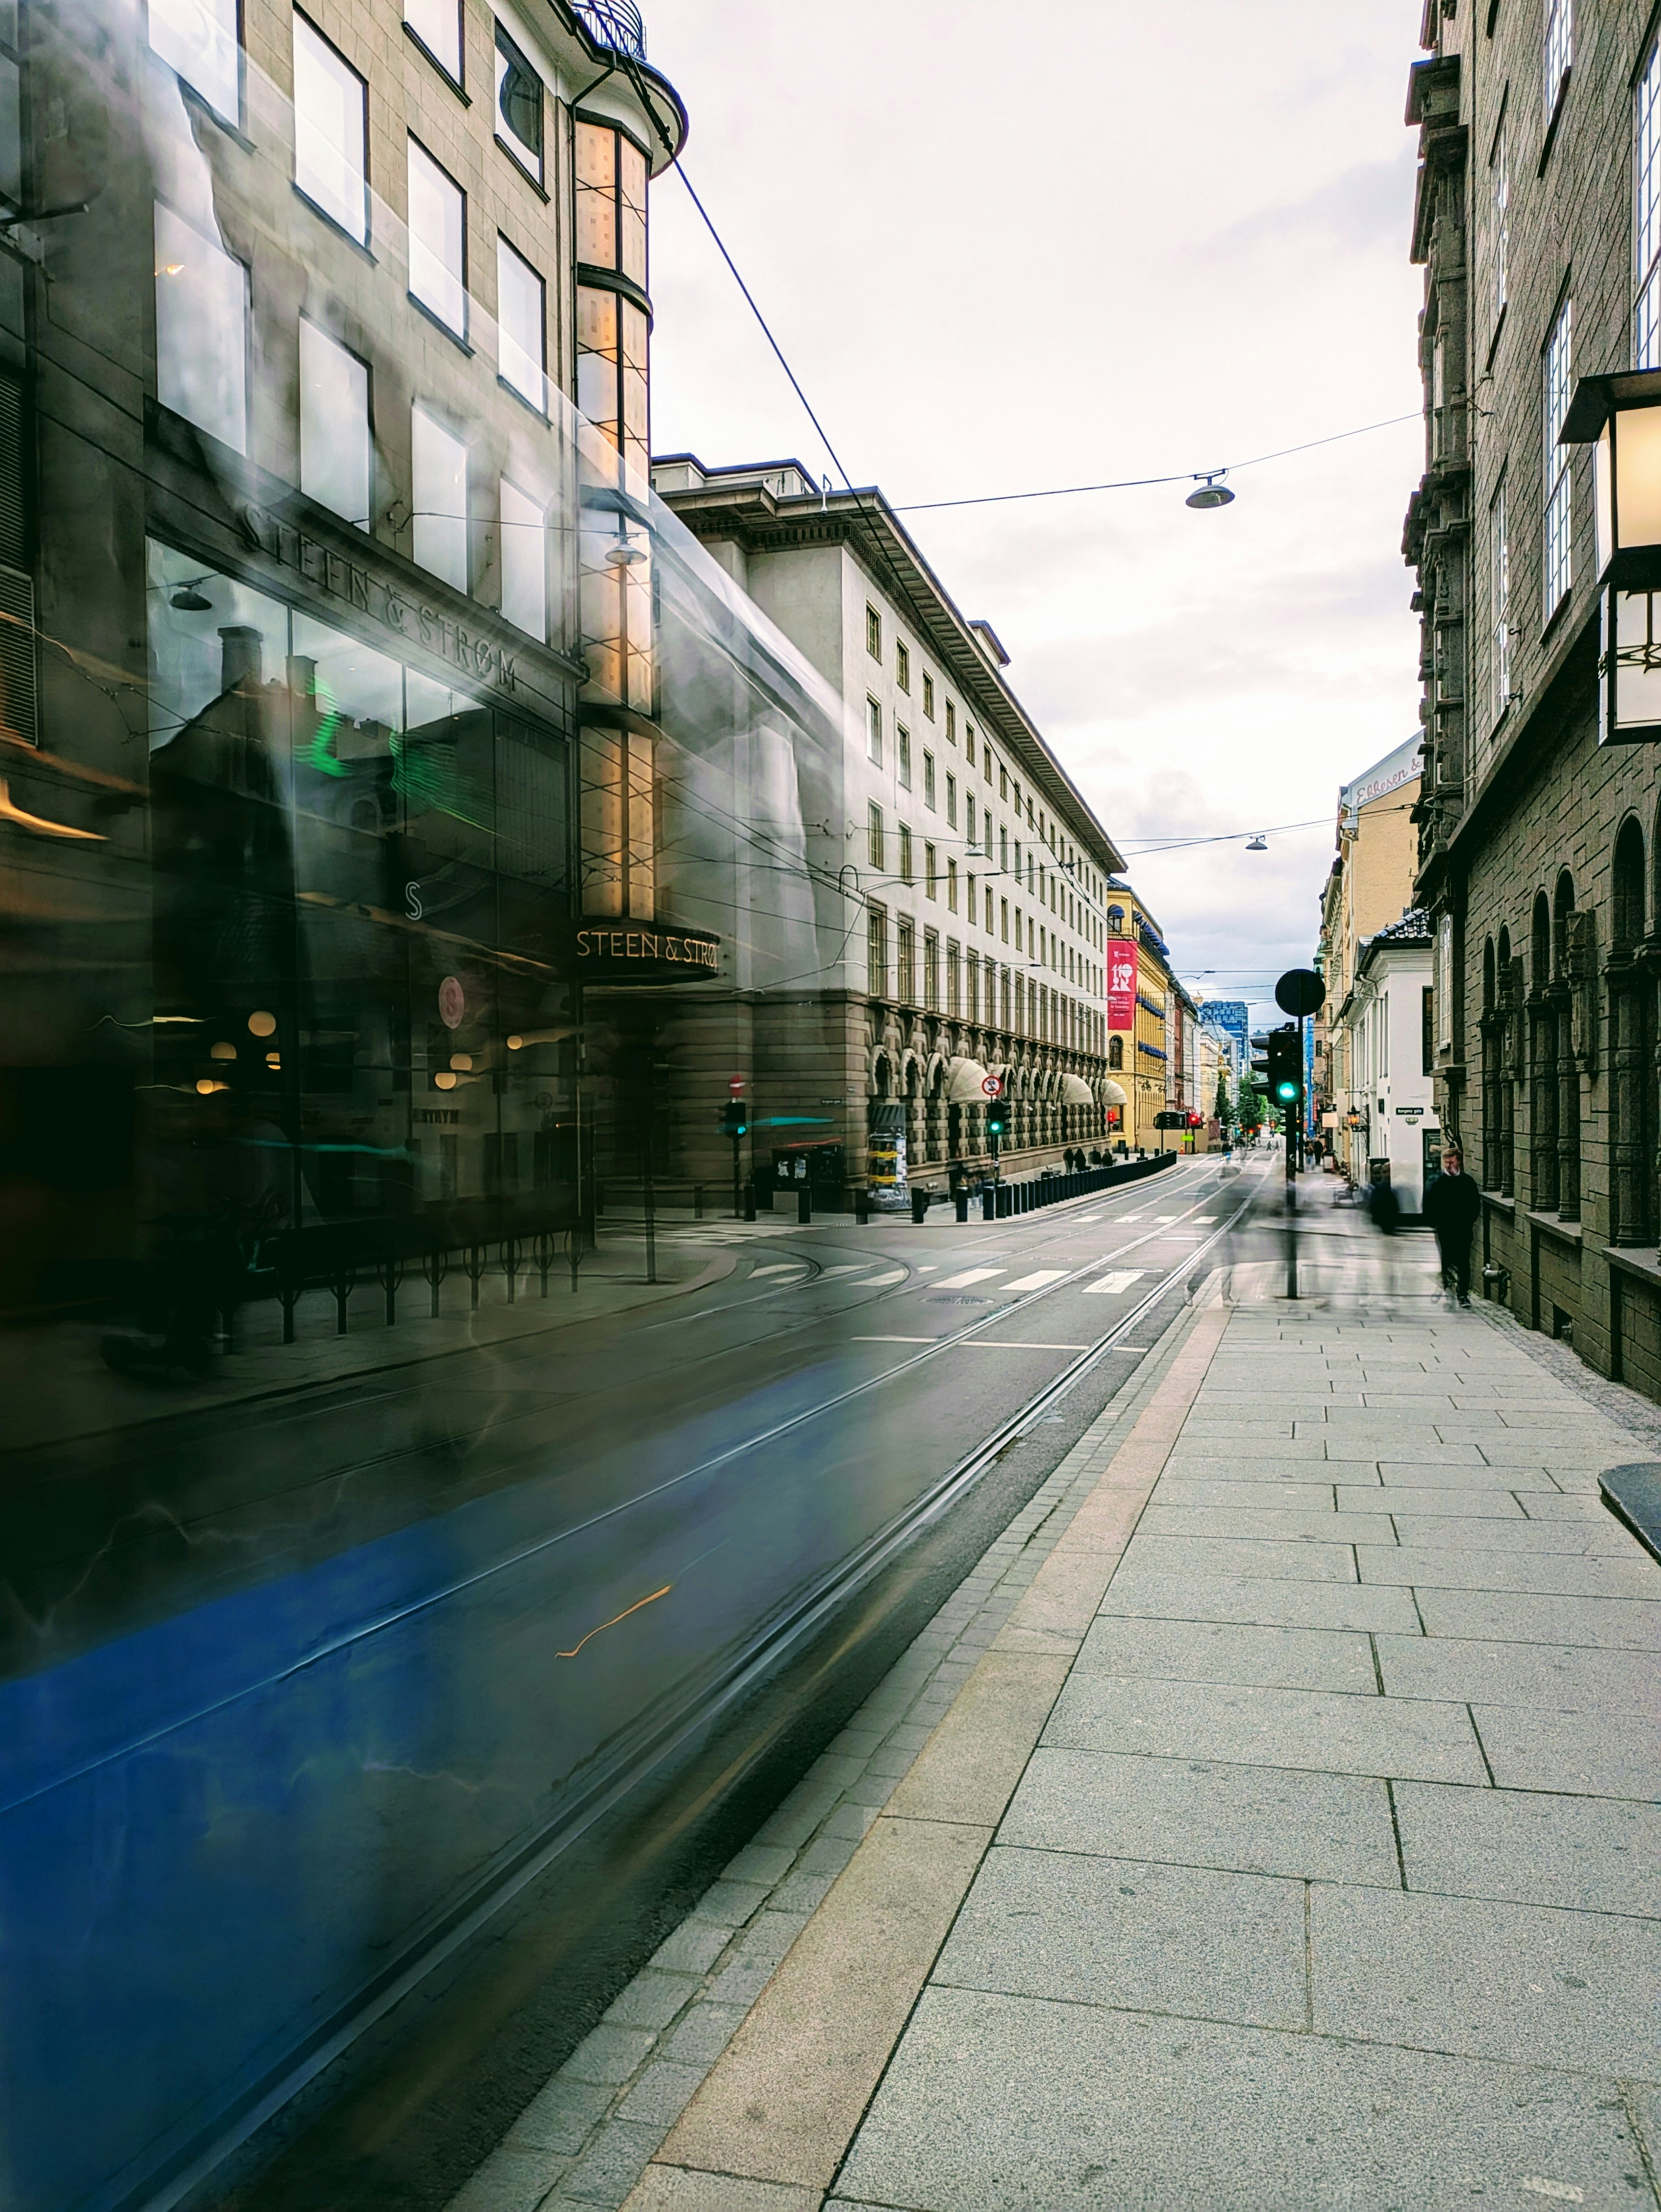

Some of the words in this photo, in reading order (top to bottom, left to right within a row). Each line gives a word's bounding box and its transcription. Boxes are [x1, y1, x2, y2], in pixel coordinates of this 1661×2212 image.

[240, 504, 368, 612] STEEN
[386, 584, 408, 633] &
[418, 604, 517, 693] STRØM
[1411, 758, 1423, 772] &
[405, 882, 422, 920] S
[576, 930, 658, 959] STEEN
[665, 936, 681, 961] &
